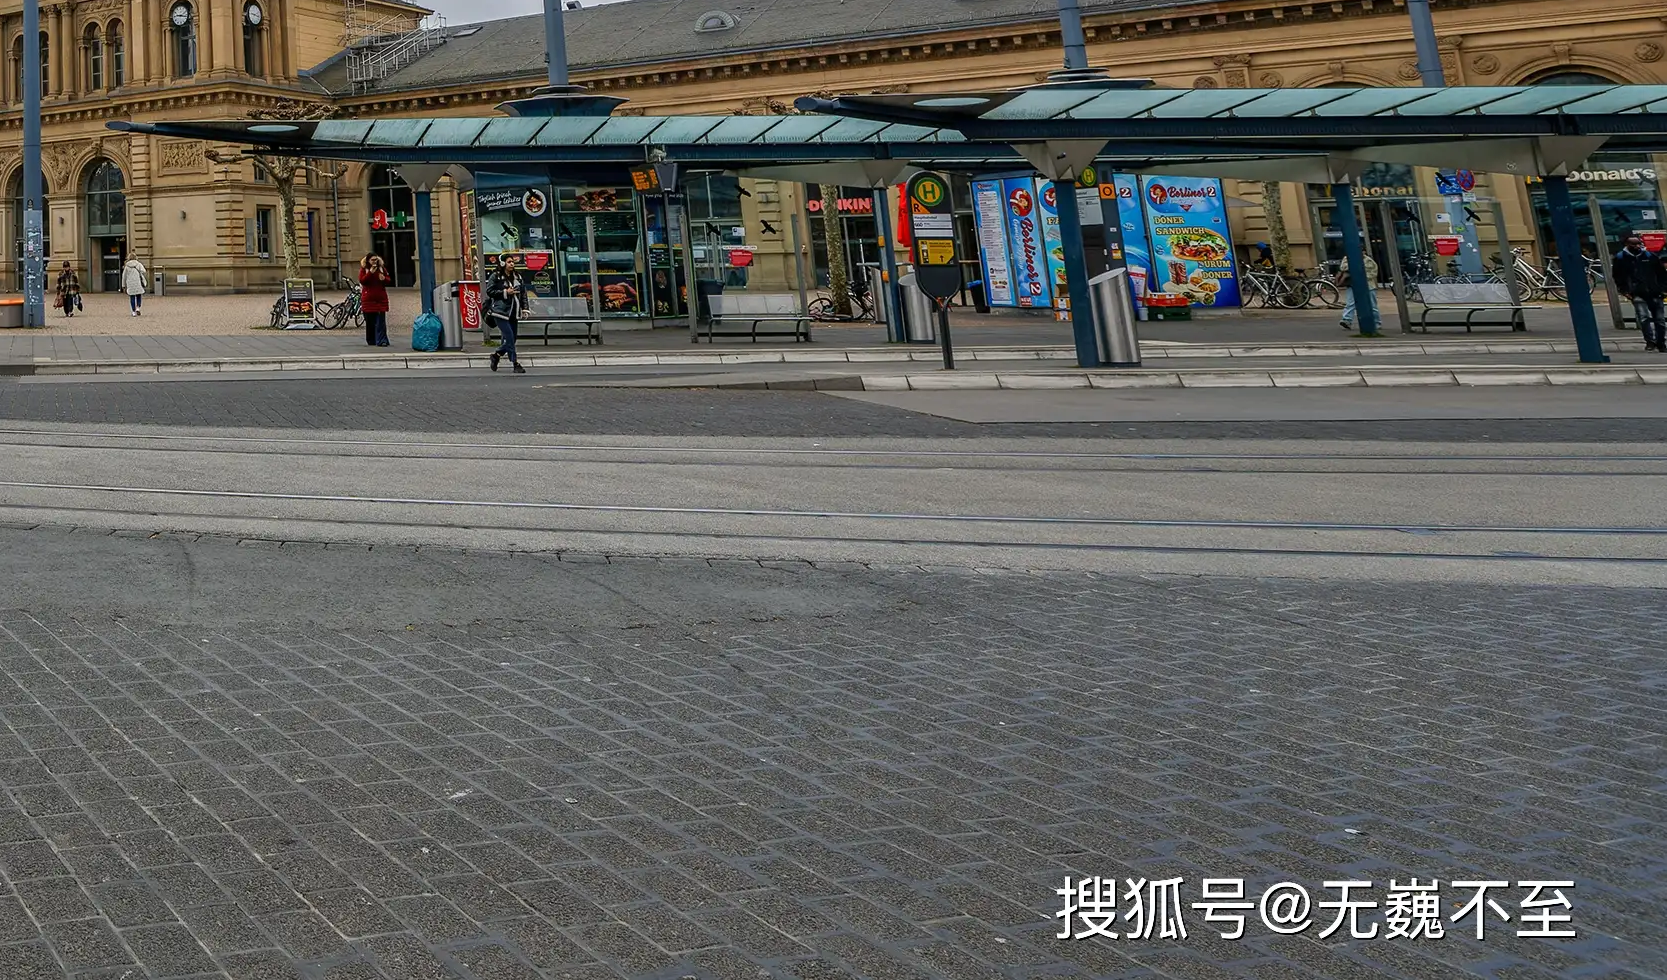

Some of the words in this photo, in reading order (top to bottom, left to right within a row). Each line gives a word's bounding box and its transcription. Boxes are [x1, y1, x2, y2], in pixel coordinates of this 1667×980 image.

[922, 184, 936, 200] H
[1120, 188, 1131, 197] 2
[1207, 187, 1216, 197] 2
[914, 204, 920, 212] R
[1156, 226, 1205, 235] SANDWICH
